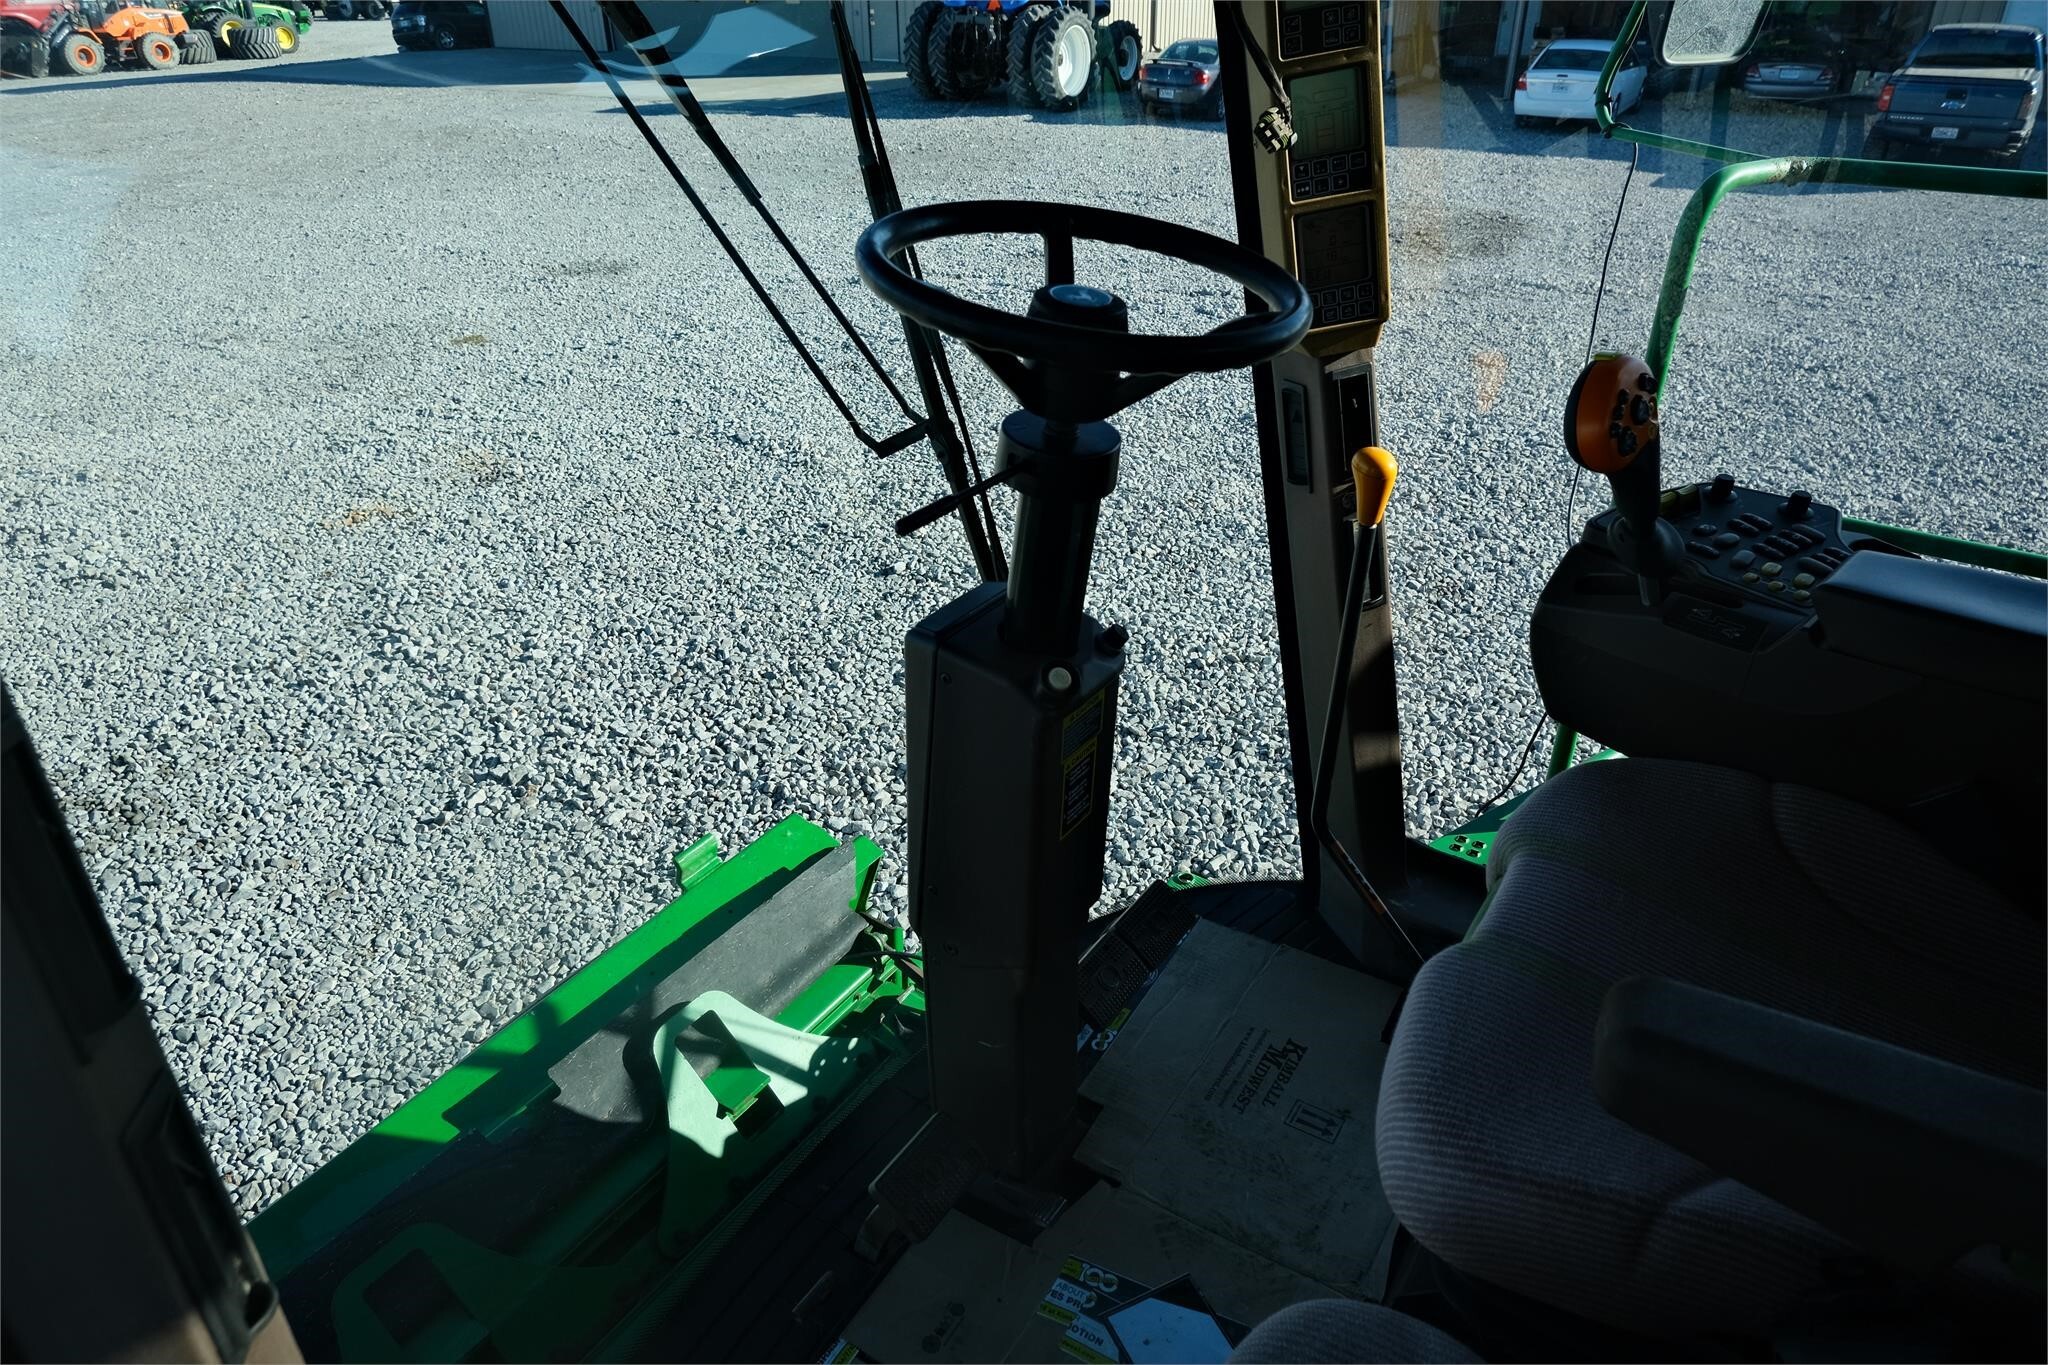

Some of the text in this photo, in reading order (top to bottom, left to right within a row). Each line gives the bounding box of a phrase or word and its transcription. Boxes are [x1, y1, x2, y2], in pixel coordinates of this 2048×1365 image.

[1233, 1044, 1284, 1115] MIDWEST
[1261, 1038, 1308, 1107] KIMBALL
[1056, 1282, 1086, 1299] ABOUT
